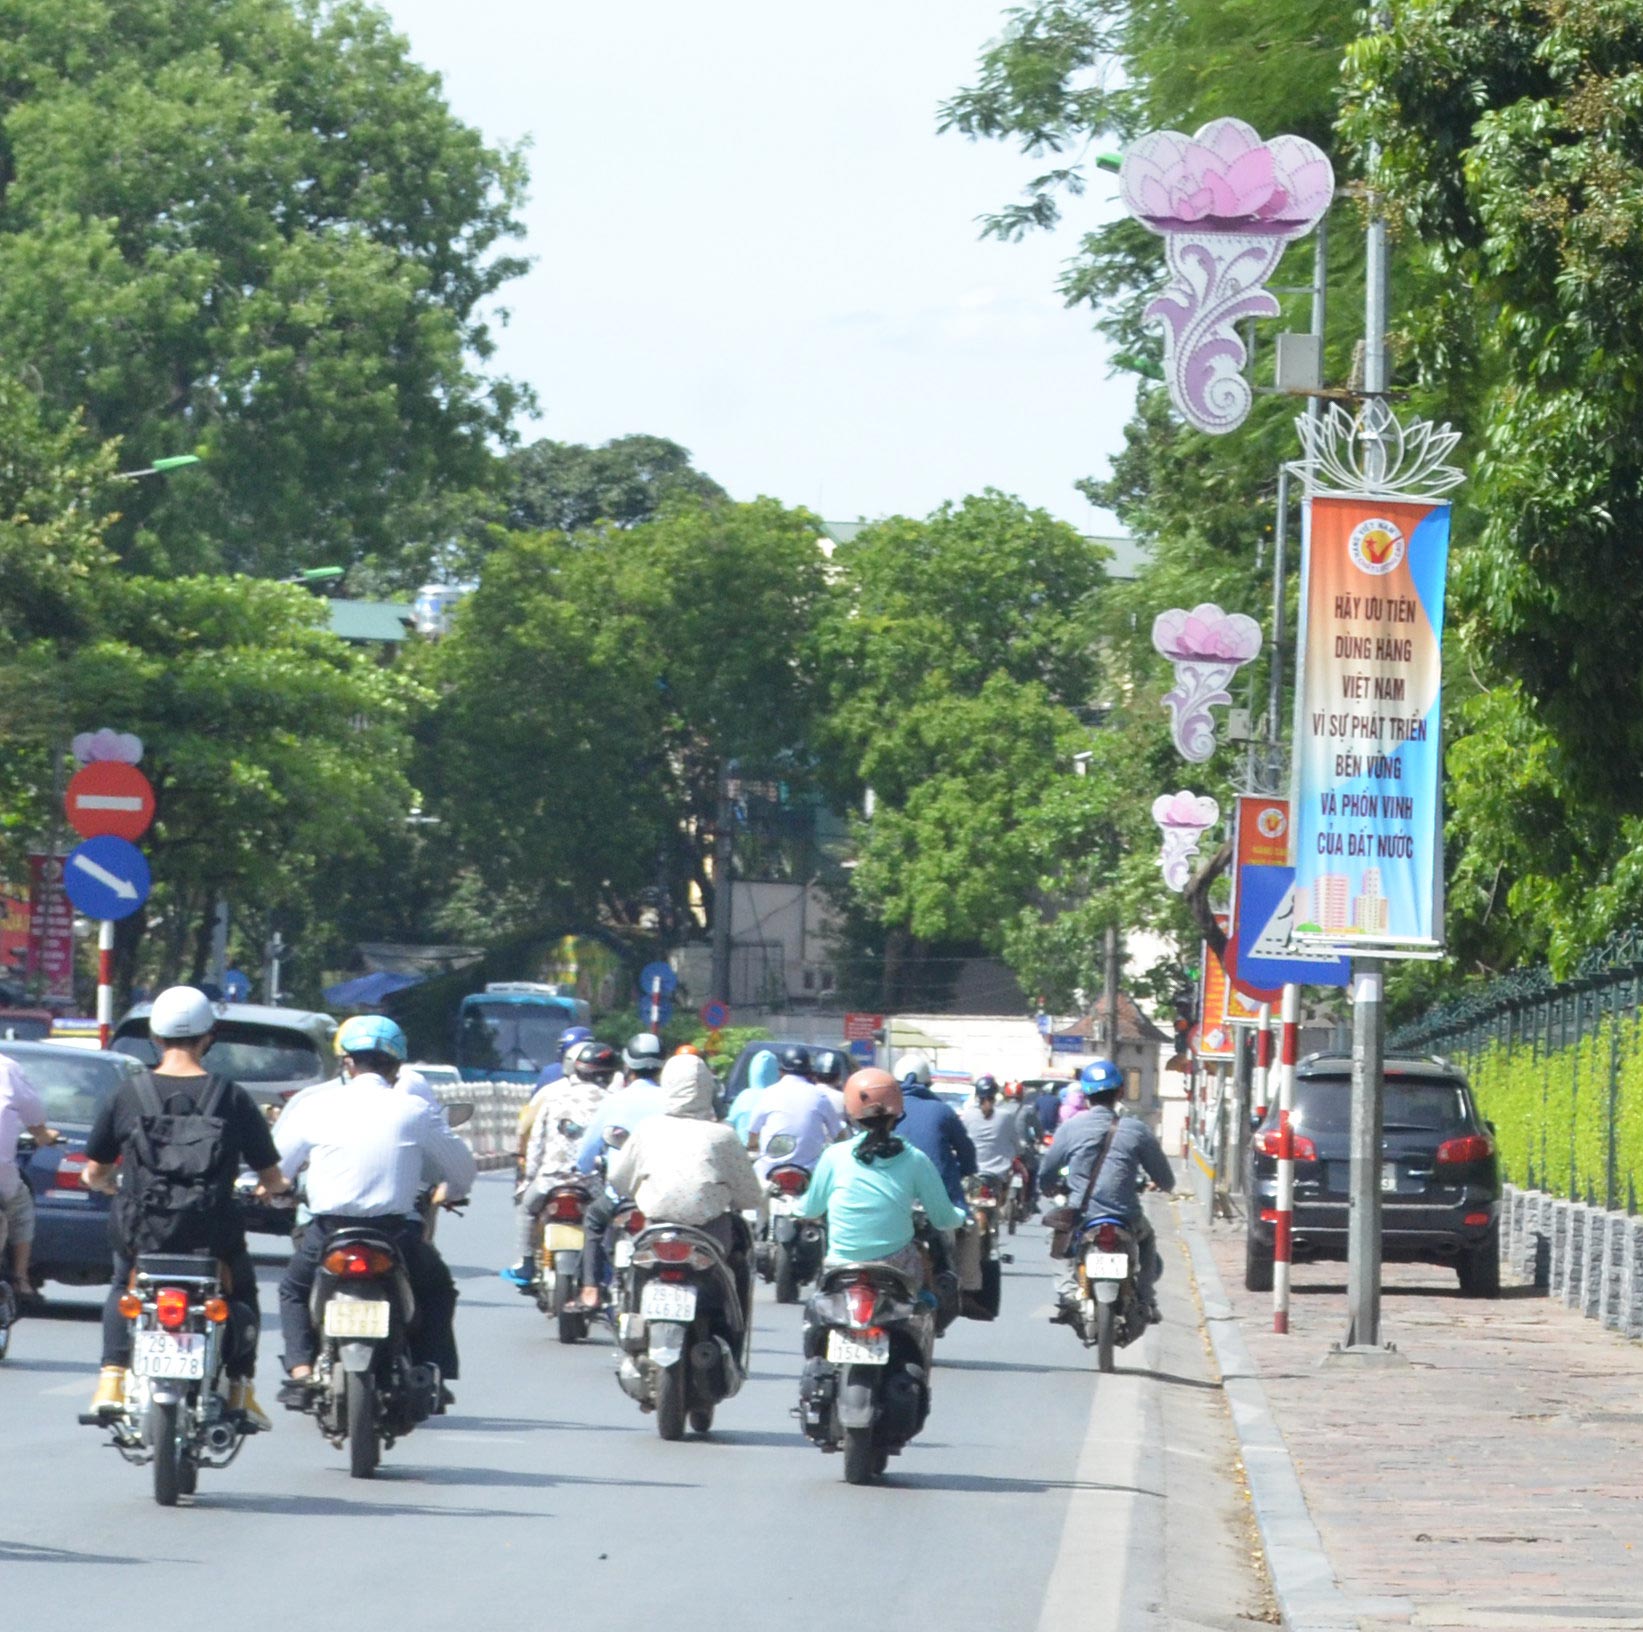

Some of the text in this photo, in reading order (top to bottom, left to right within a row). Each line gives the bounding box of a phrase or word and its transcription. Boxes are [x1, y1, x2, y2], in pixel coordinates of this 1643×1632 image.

[1334, 592, 1361, 620] HÃY
[1386, 594, 1416, 622] TIÊN
[1335, 631, 1412, 662] DÙNG HÀNG
[1342, 671, 1405, 704] VIỆT NAM
[1313, 708, 1427, 742] VÌ SỰ PHÁT TRIỂN
[1335, 746, 1362, 777] BỀN
[1320, 788, 1337, 816] VÀ
[1382, 795, 1413, 819] VINH
[1317, 822, 1344, 856] CỦA
[1377, 828, 1414, 859] NƯỚC
